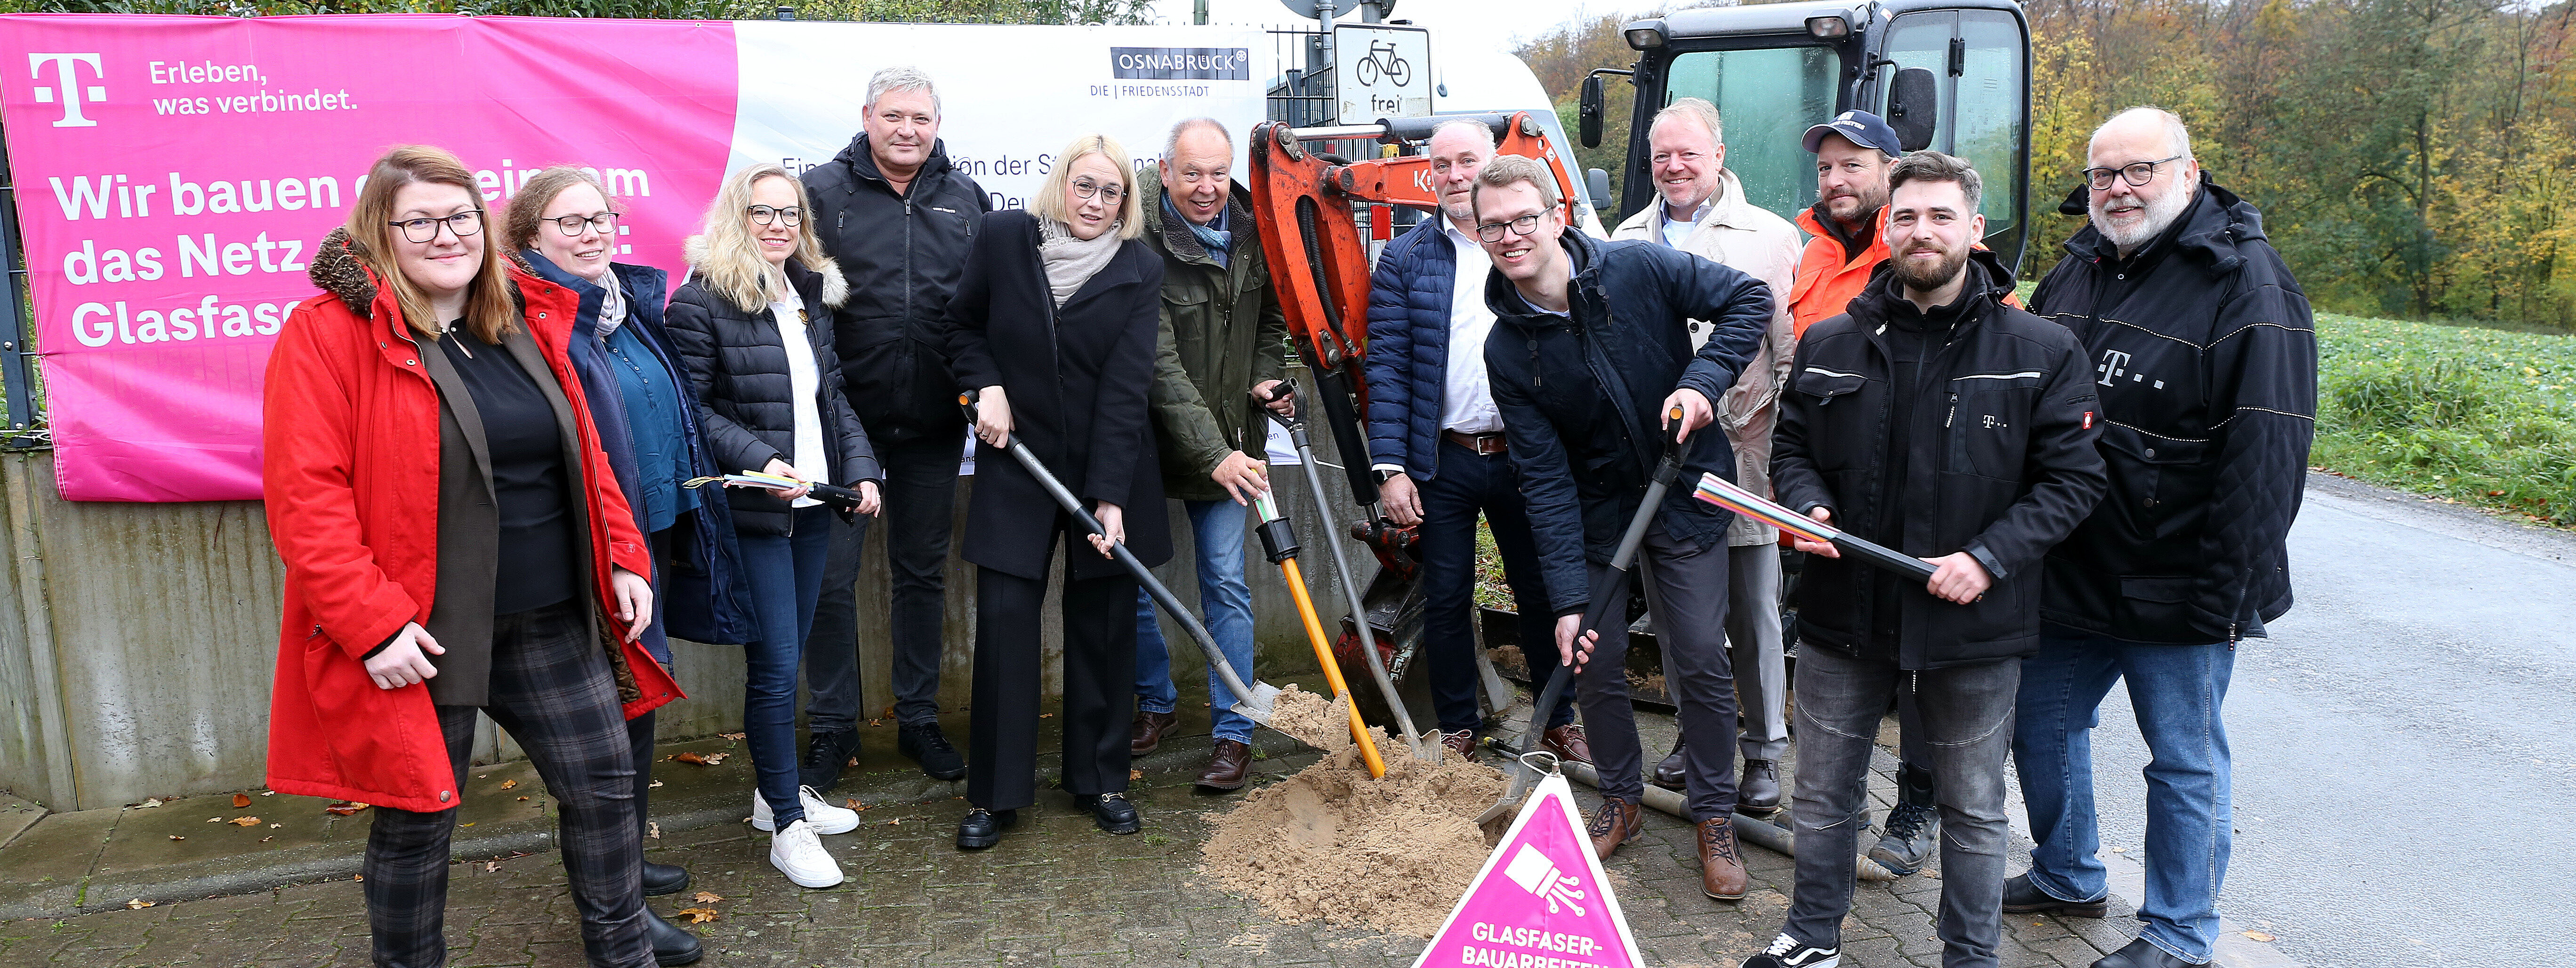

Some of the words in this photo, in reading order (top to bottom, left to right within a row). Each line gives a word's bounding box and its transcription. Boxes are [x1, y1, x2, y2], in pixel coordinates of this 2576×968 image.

[149, 60, 267, 86] Erleben,
[153, 97, 210, 116] was
[220, 88, 358, 114] verbindet.
[1090, 85, 1109, 96] DIE
[1123, 86, 1209, 97] FRIEDENSSTADT
[1371, 94, 1401, 115] frei
[994, 154, 1031, 176] der
[48, 174, 156, 221] Wir
[169, 172, 341, 216] bauen
[64, 240, 164, 285] das
[177, 230, 306, 278] Netz
[72, 295, 302, 347] Glasfas
[1472, 921, 1603, 957] GLASFASER-
[1461, 945, 1609, 968] BAUARBE
